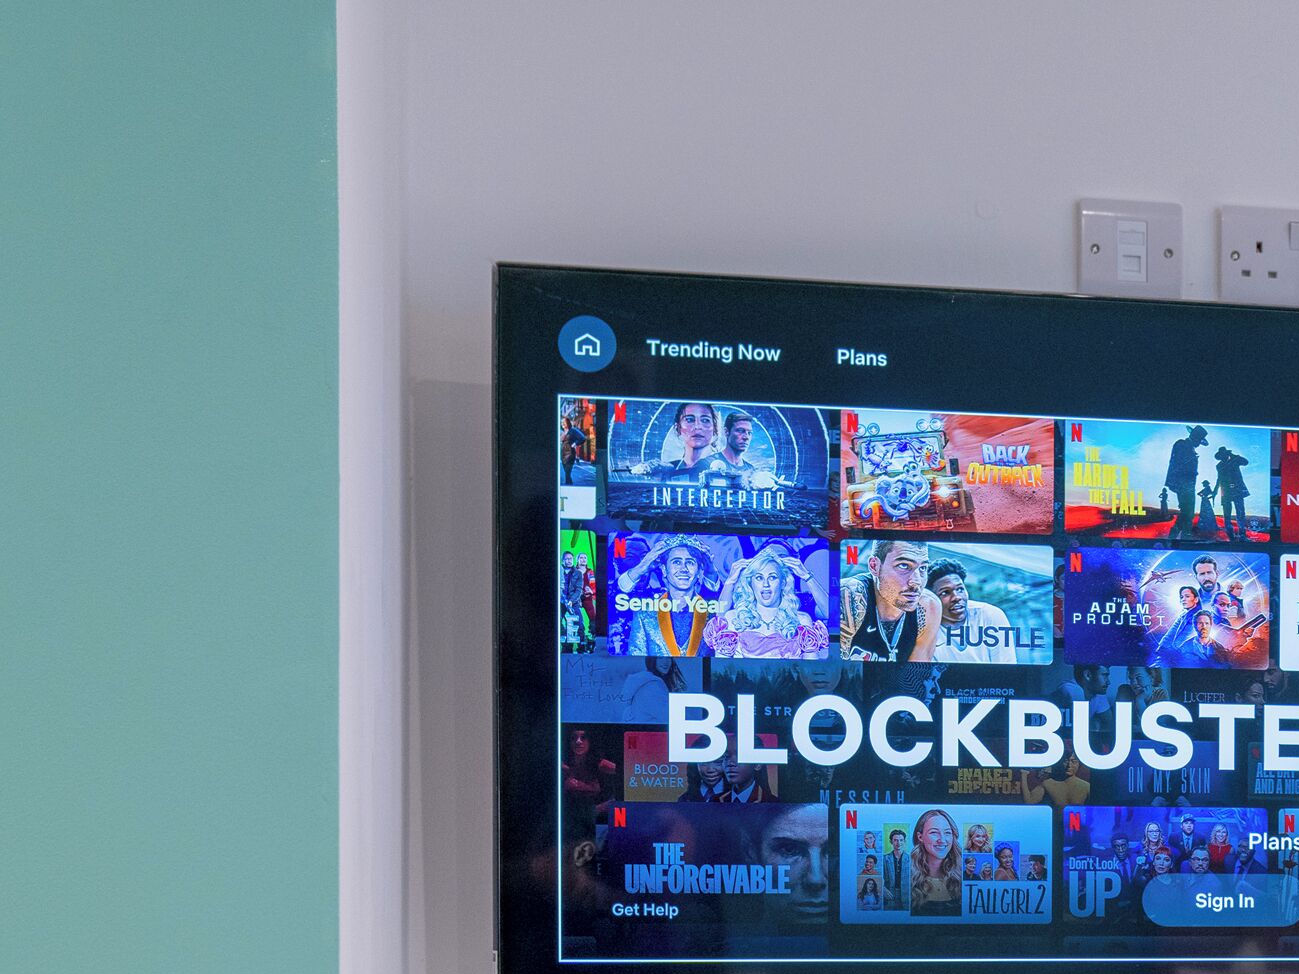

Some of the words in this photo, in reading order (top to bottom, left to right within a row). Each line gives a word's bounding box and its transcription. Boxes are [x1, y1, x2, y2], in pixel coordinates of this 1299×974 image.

[647, 339, 732, 363] Trending
[738, 344, 781, 361] Now
[837, 349, 887, 367] Plans
[981, 444, 1030, 466] BACK
[966, 463, 1045, 488] OUTBACK
[1073, 462, 1129, 489] HARDER
[653, 487, 785, 510] INTERCEPTOR
[1089, 488, 1110, 504] THEY
[1111, 489, 1146, 515] FALL
[614, 593, 682, 613] Senior
[685, 595, 728, 614] Year
[1090, 602, 1149, 614] ADAM
[1073, 613, 1165, 626] PROJECT
[946, 626, 1046, 649] HUSTLE
[945, 688, 976, 696] BLACK
[977, 687, 1015, 696] MIRROR
[1183, 690, 1225, 703] LUCIFER
[634, 763, 679, 775] BLOOD
[628, 777, 639, 788] &
[641, 777, 685, 788] WATER
[1128, 767, 1143, 793] ON
[1153, 768, 1171, 793] MY
[1181, 767, 1211, 794] SKIN
[1254, 778, 1274, 794] AND
[820, 789, 905, 808] MESSIAH
[653, 842, 685, 865] THE
[1069, 857, 1093, 870] Don't
[1095, 857, 1120, 870] Look
[624, 864, 791, 894] UNFORGIVABLE
[1034, 884, 1047, 914] 2
[1069, 871, 1122, 918] UP
[1195, 893, 1234, 912] Sign
[1239, 893, 1255, 908] In
[612, 903, 640, 917] Get
[643, 902, 679, 919] Help
